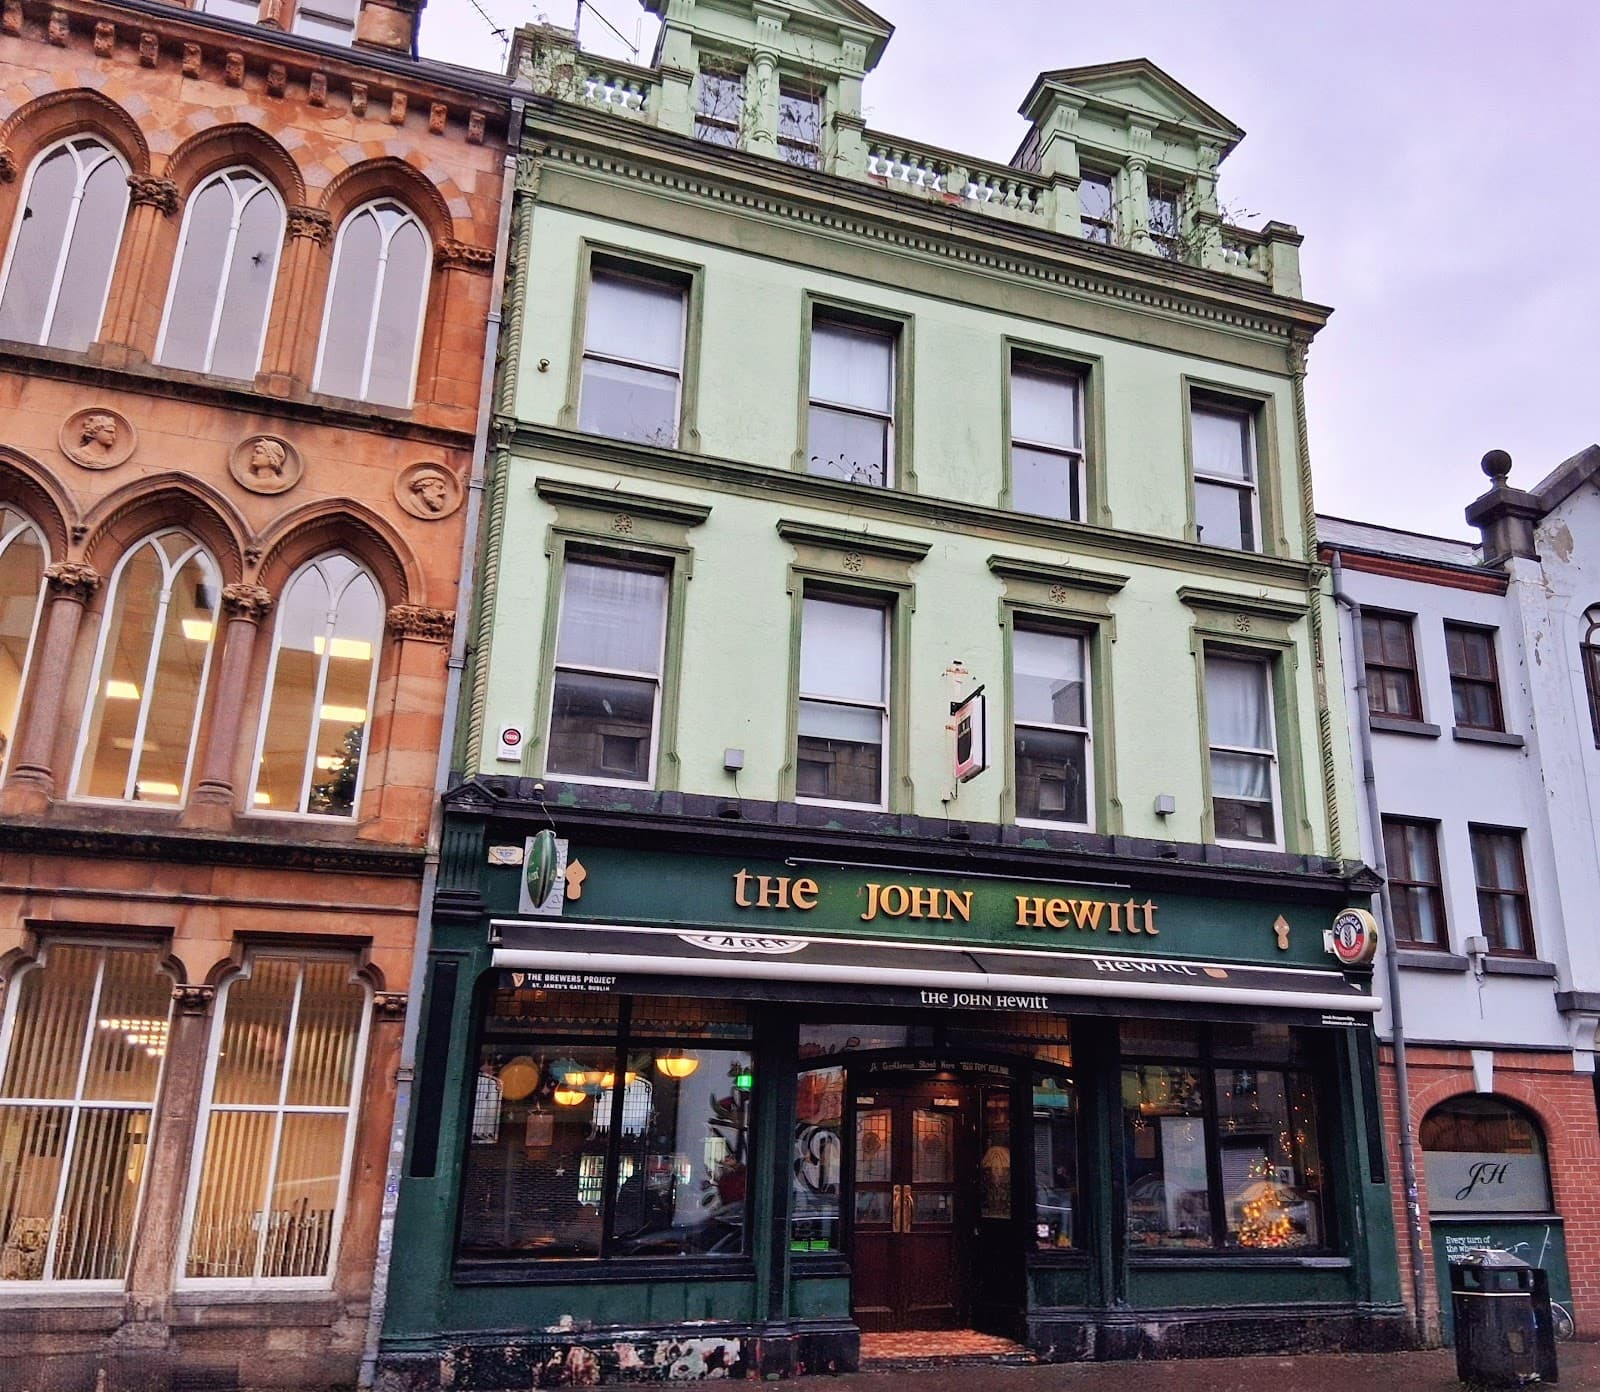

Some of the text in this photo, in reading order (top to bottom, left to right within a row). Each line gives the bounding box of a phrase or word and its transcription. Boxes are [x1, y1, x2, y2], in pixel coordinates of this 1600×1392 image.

[860, 883, 974, 922] JOHN
[1335, 913, 1362, 937] ERDINGER
[527, 973, 617, 985] THE BREWERS PROJECT
[952, 993, 992, 1008] JOHN
[1456, 1162, 1513, 1201] JH
[1446, 1235, 1490, 1245] Every turn of
[1446, 1244, 1458, 1253] the
